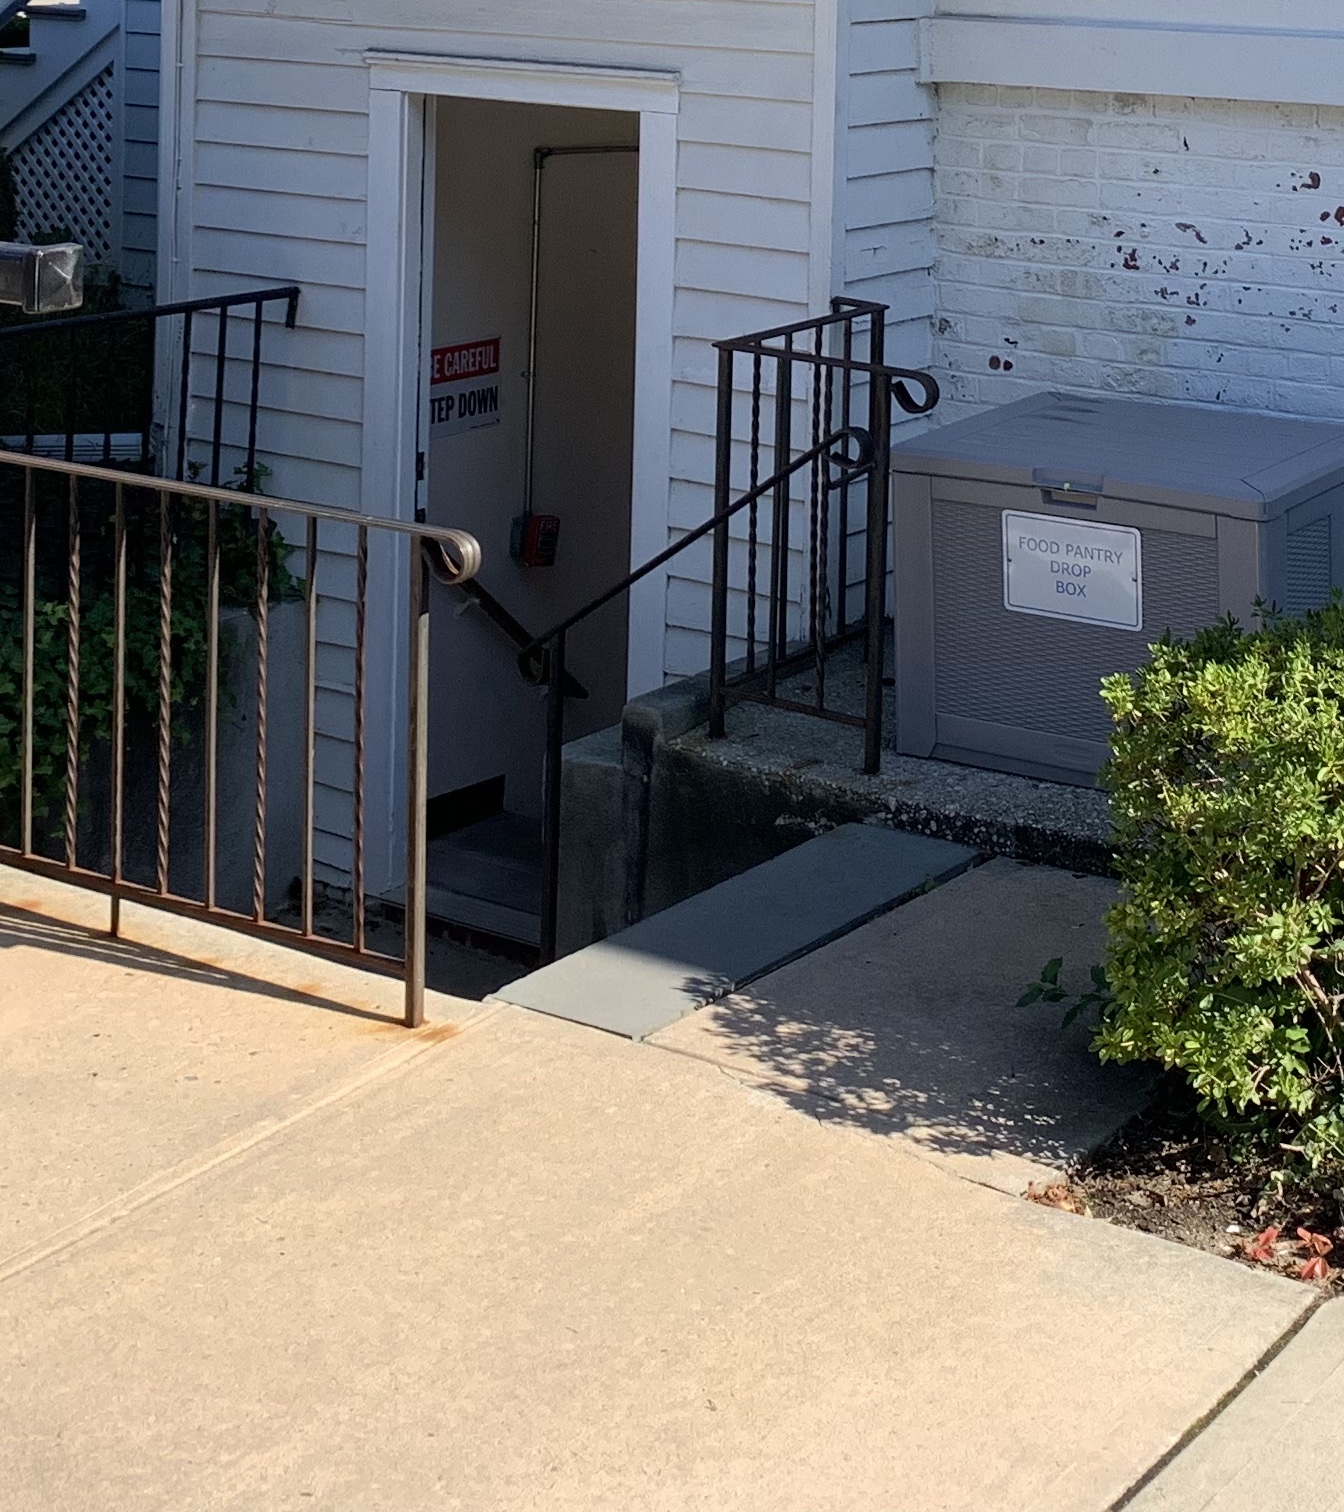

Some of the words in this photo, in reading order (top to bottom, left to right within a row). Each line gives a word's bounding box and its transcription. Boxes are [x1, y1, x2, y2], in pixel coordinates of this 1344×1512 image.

[444, 345, 497, 377] CAREFUL
[430, 394, 455, 425] TEP
[458, 385, 498, 419] DOWN
[1018, 537, 1060, 554] FOOD
[1065, 544, 1123, 566] PANTRY
[1050, 560, 1092, 578] DROP
[1056, 580, 1087, 598] BOX
